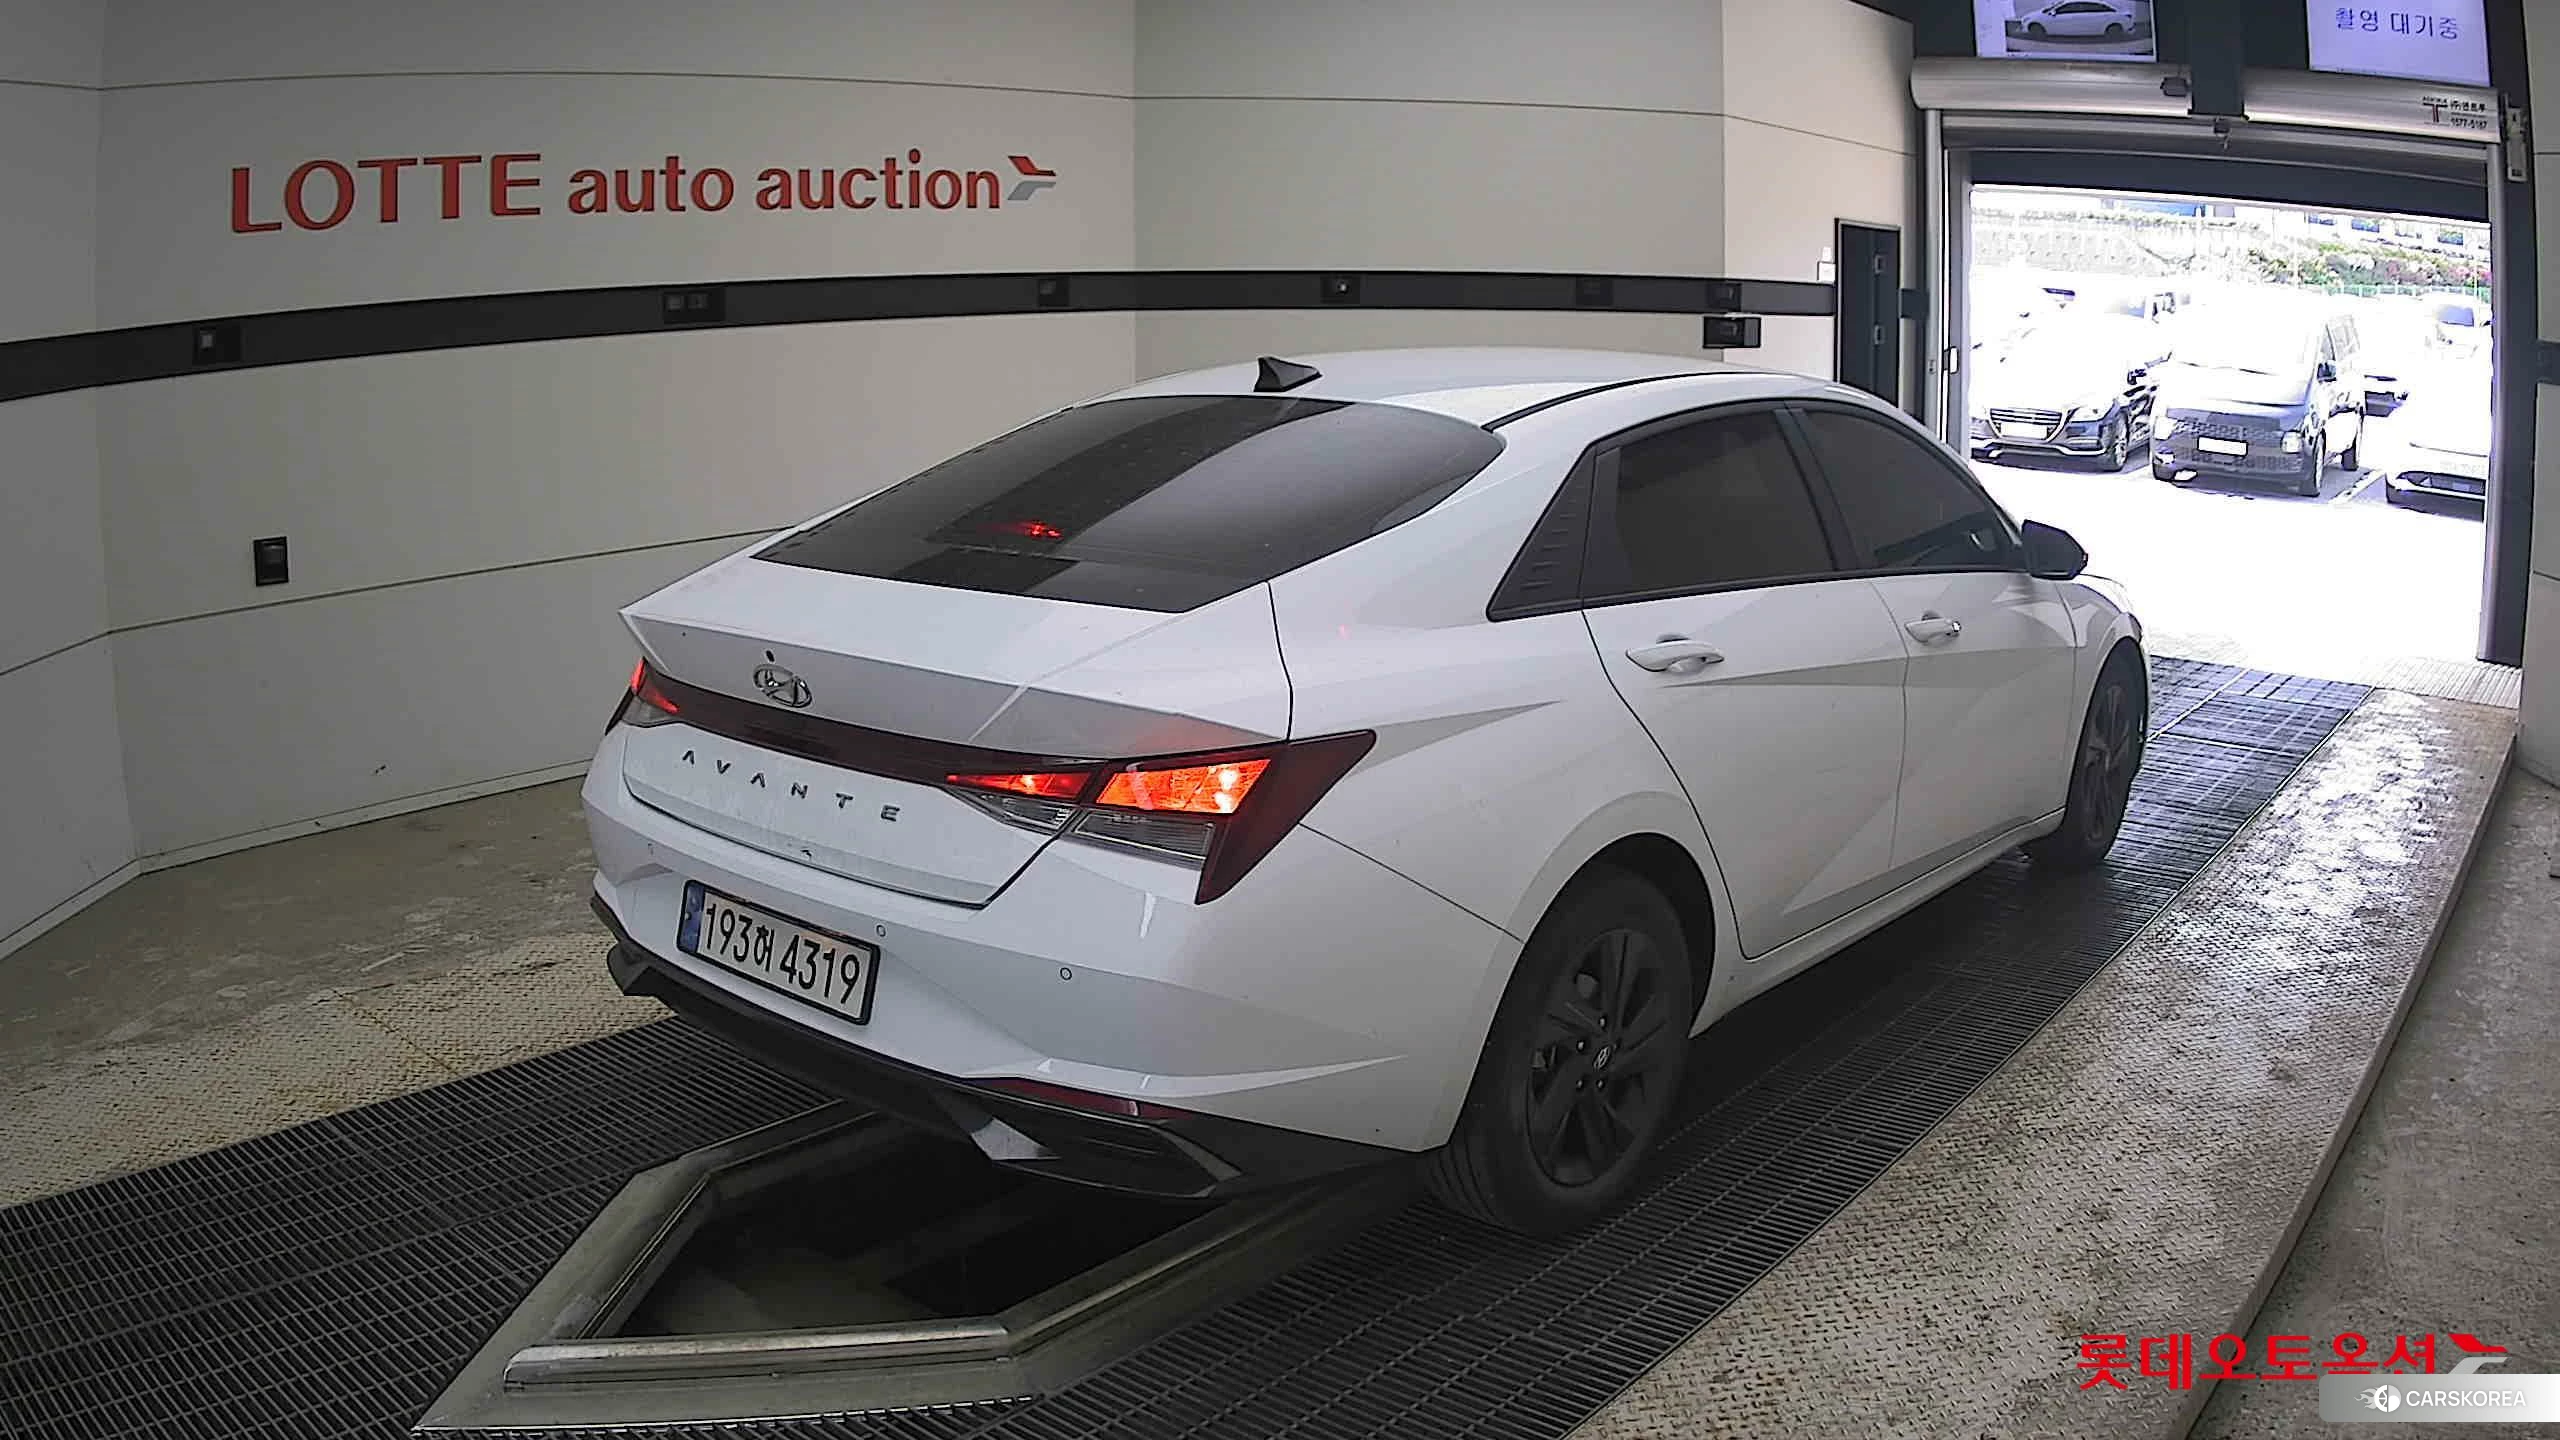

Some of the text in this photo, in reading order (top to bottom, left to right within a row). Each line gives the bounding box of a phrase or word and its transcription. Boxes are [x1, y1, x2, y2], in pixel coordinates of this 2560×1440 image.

[2335, 7, 2458, 40] 촬영 대기중
[231, 147, 1001, 233] LOTTE auto auction
[682, 749, 901, 822] AVANTE
[706, 903, 860, 1004] 193허 4319
